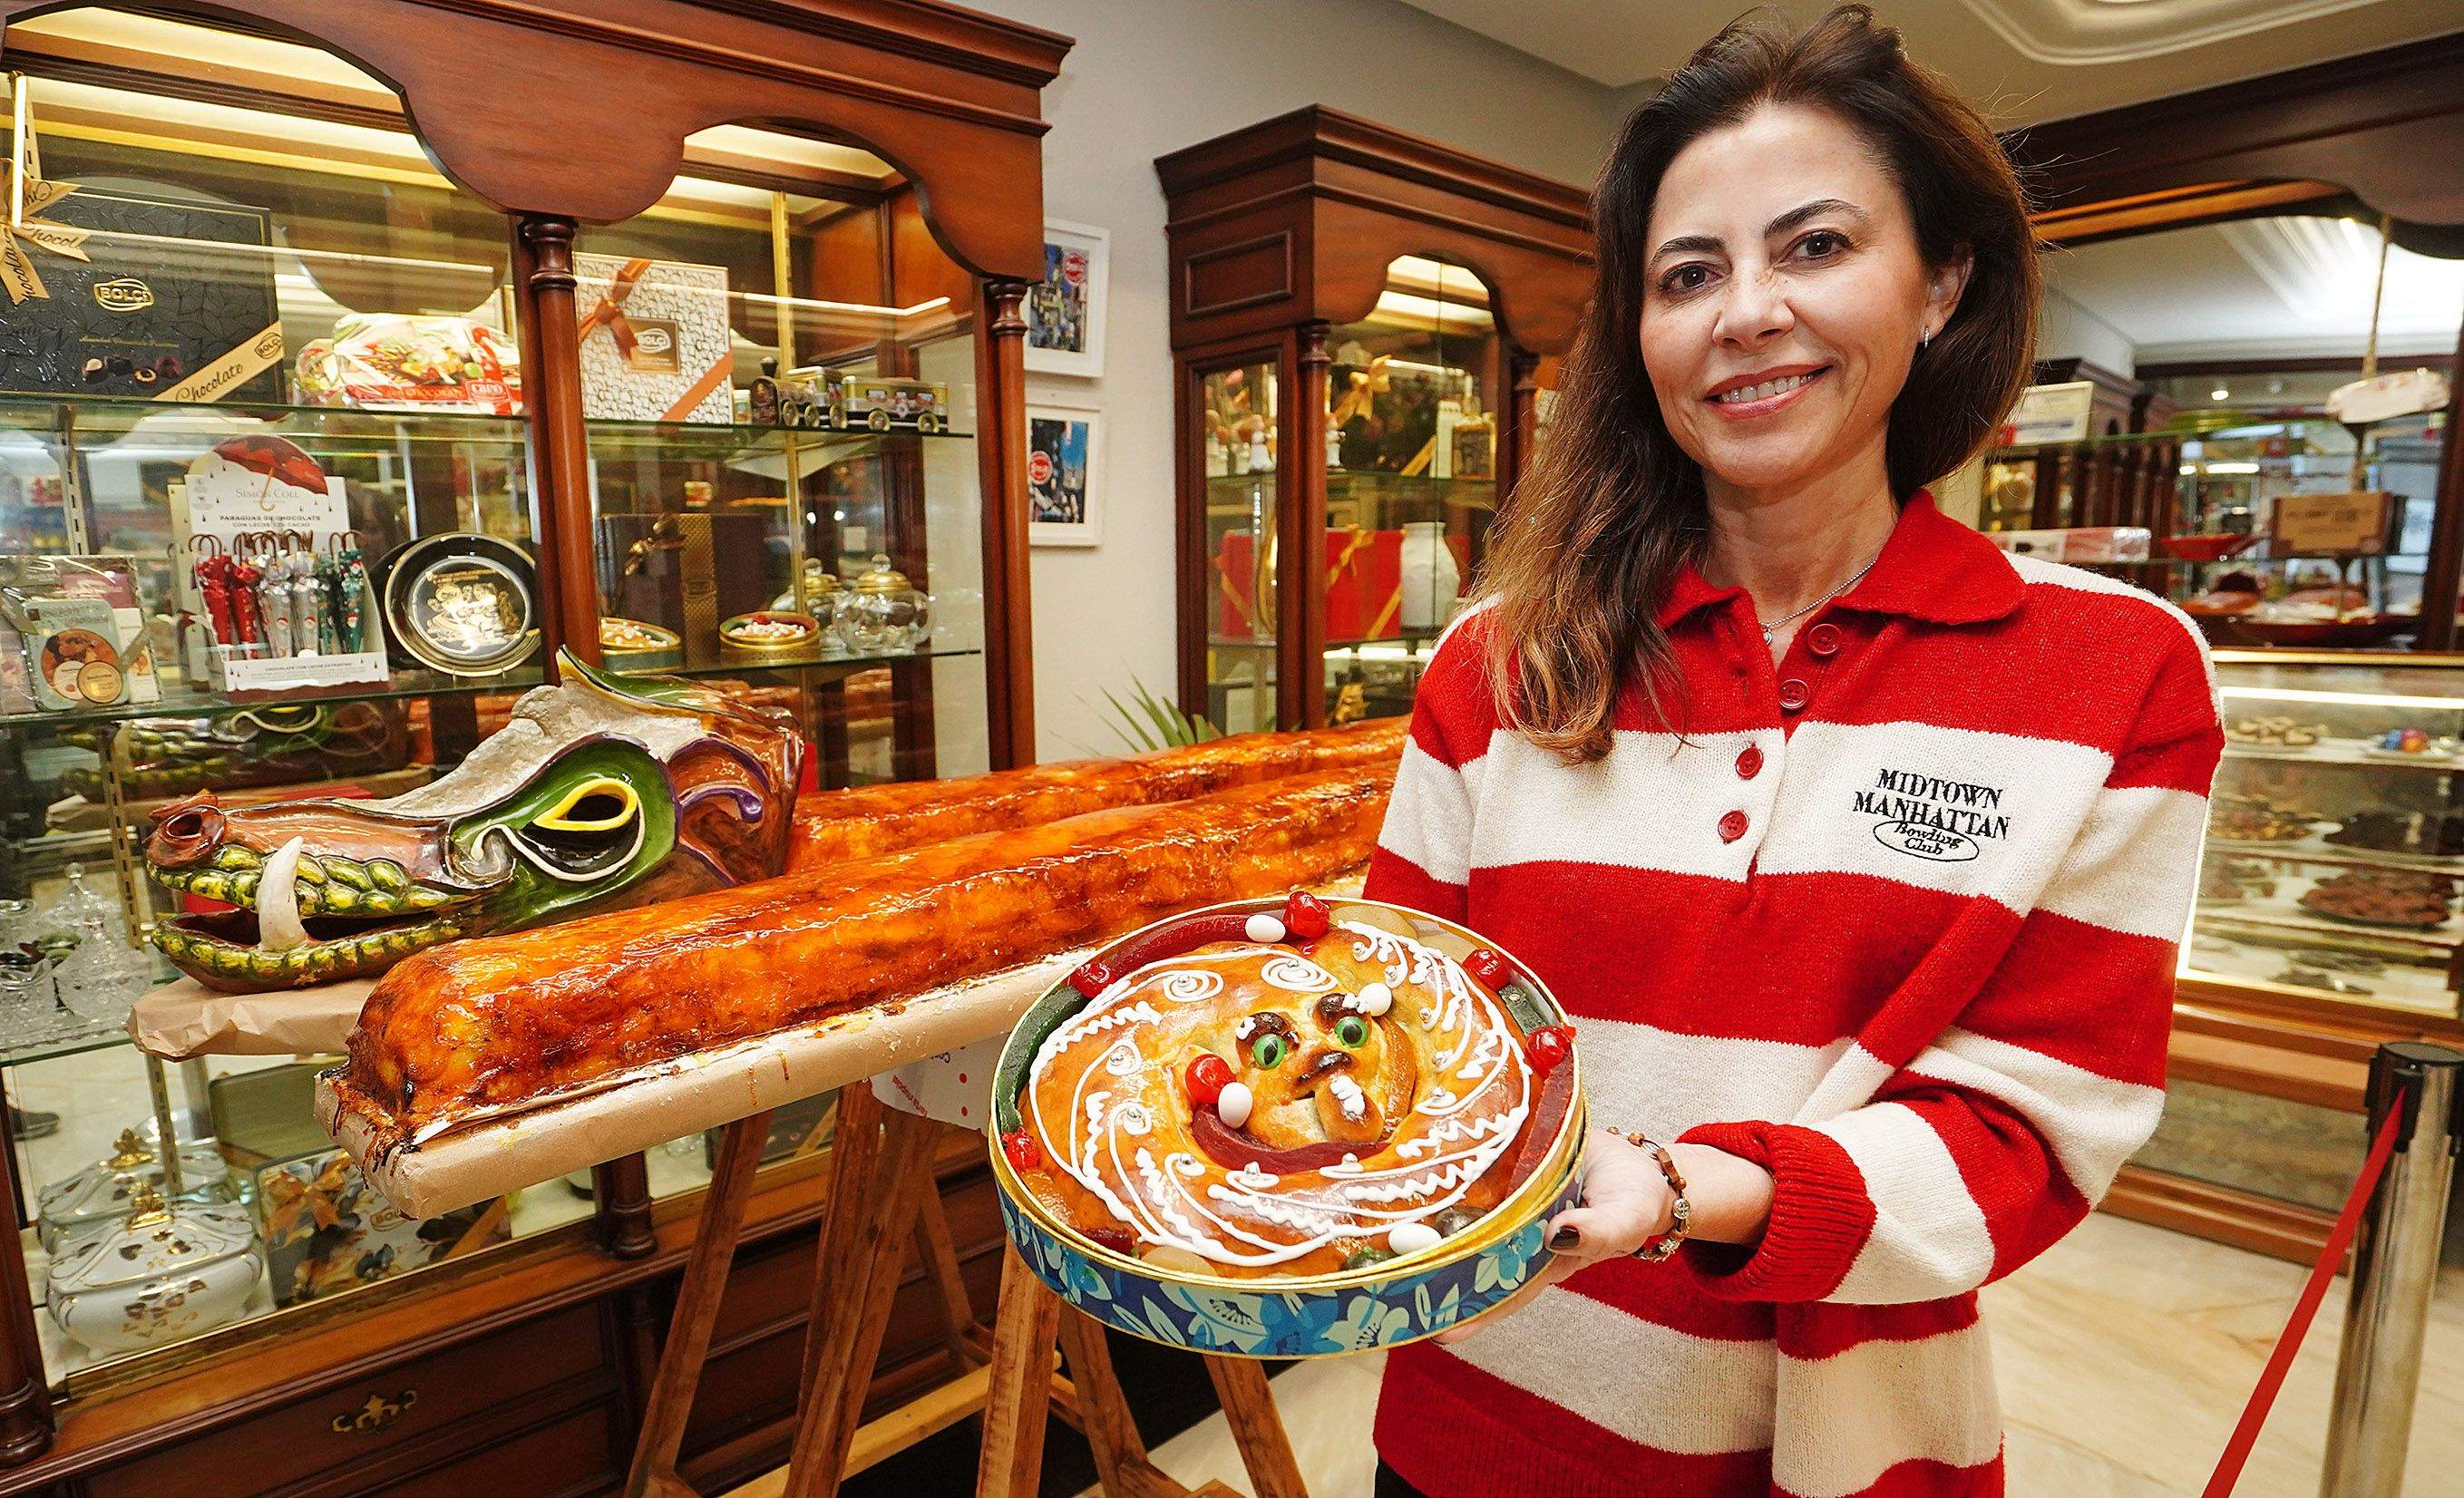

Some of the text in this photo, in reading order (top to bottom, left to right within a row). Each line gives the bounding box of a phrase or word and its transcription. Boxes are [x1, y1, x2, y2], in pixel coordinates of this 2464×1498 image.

[1875, 768, 2003, 810] MIDTOWN
[1853, 792, 2011, 841] MANHATTAN
[1894, 822, 1964, 850] Bowling
[1904, 838, 1943, 856] Club
